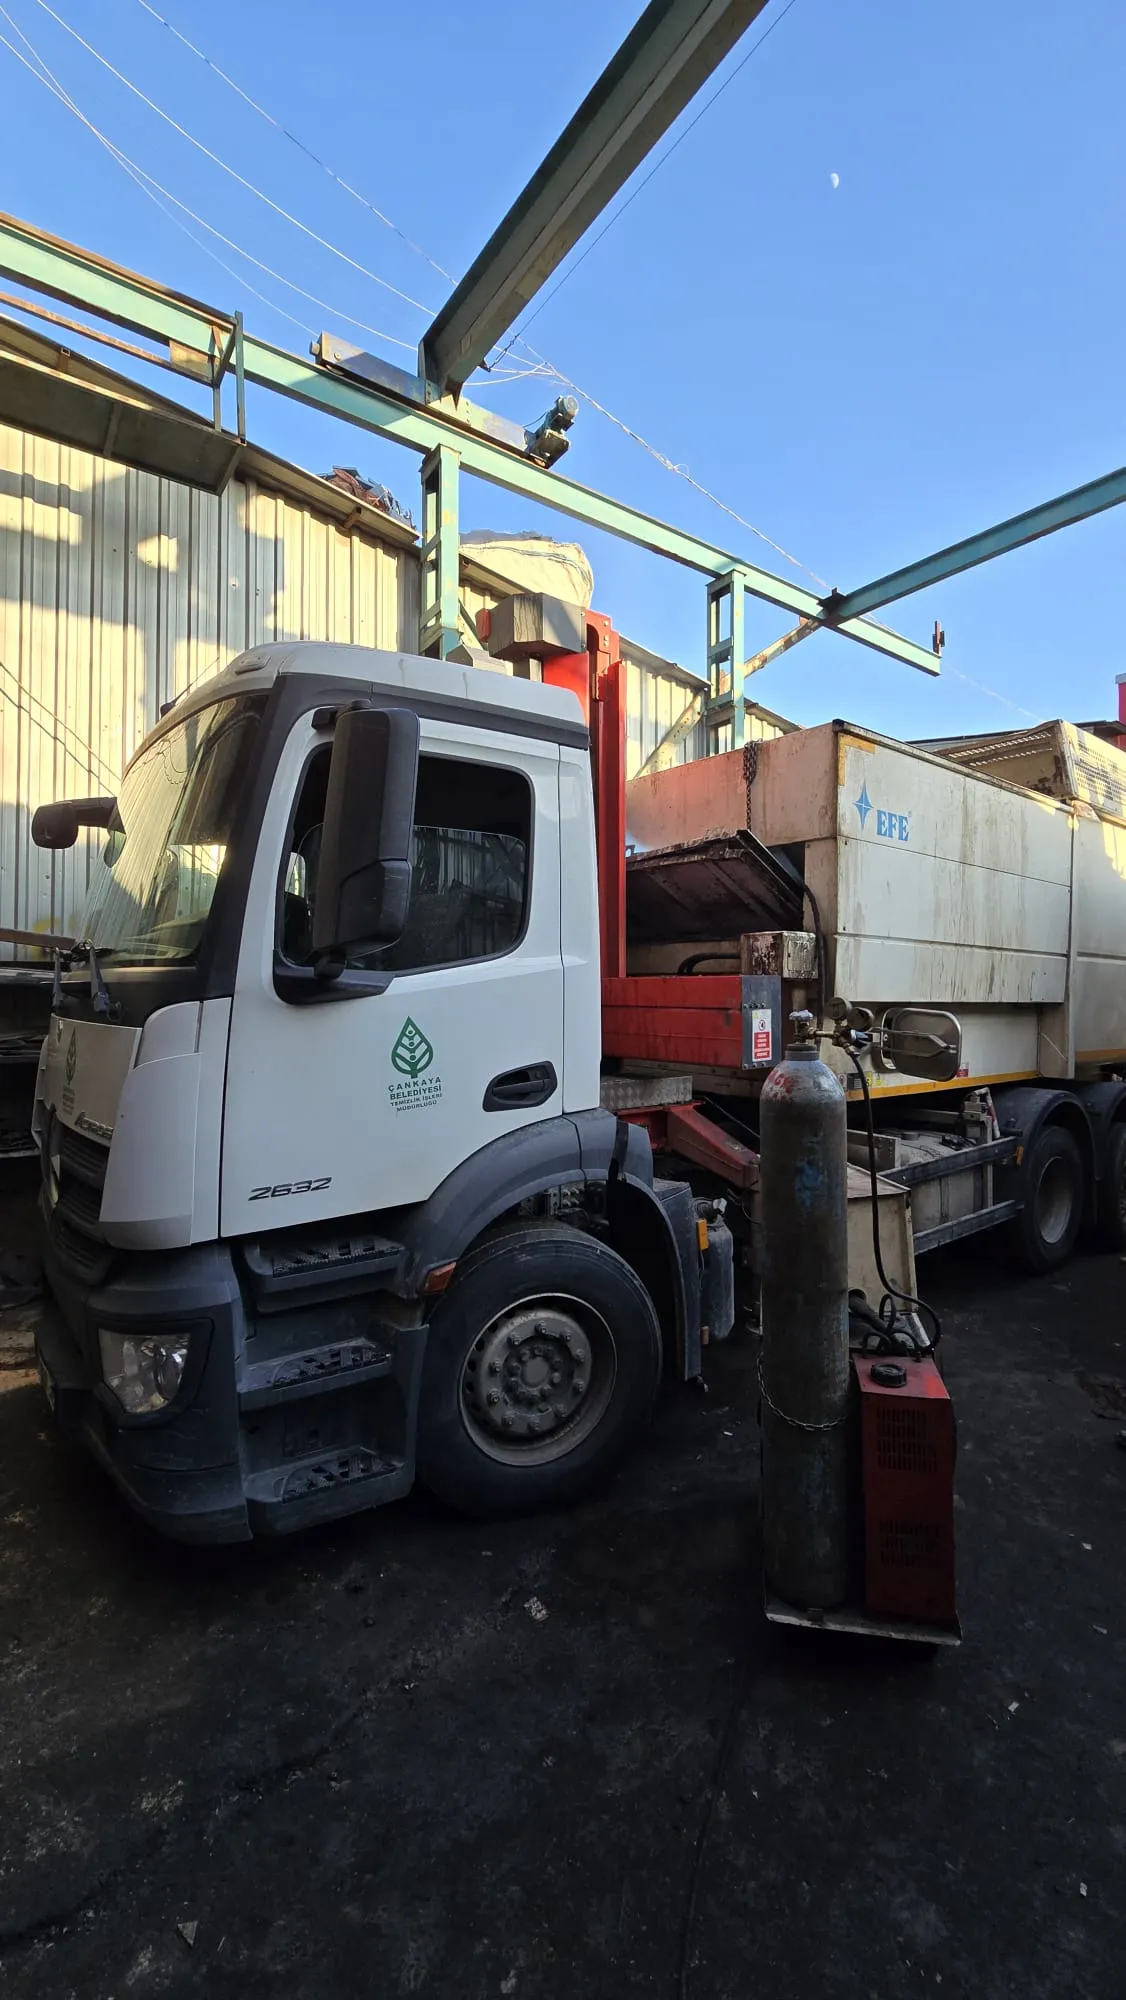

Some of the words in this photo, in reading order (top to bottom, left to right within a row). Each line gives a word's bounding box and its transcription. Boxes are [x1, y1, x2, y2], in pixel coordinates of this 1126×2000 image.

[876, 809, 909, 841] EFE
[388, 1076, 441, 1093] ÇANKAYA
[390, 1083, 441, 1100] BELEDİYESİ
[390, 1096, 421, 1107] TEMİZLİK
[397, 1100, 437, 1112] MÜDÜRLÜĞÜ
[247, 1176, 333, 1202] 2632
